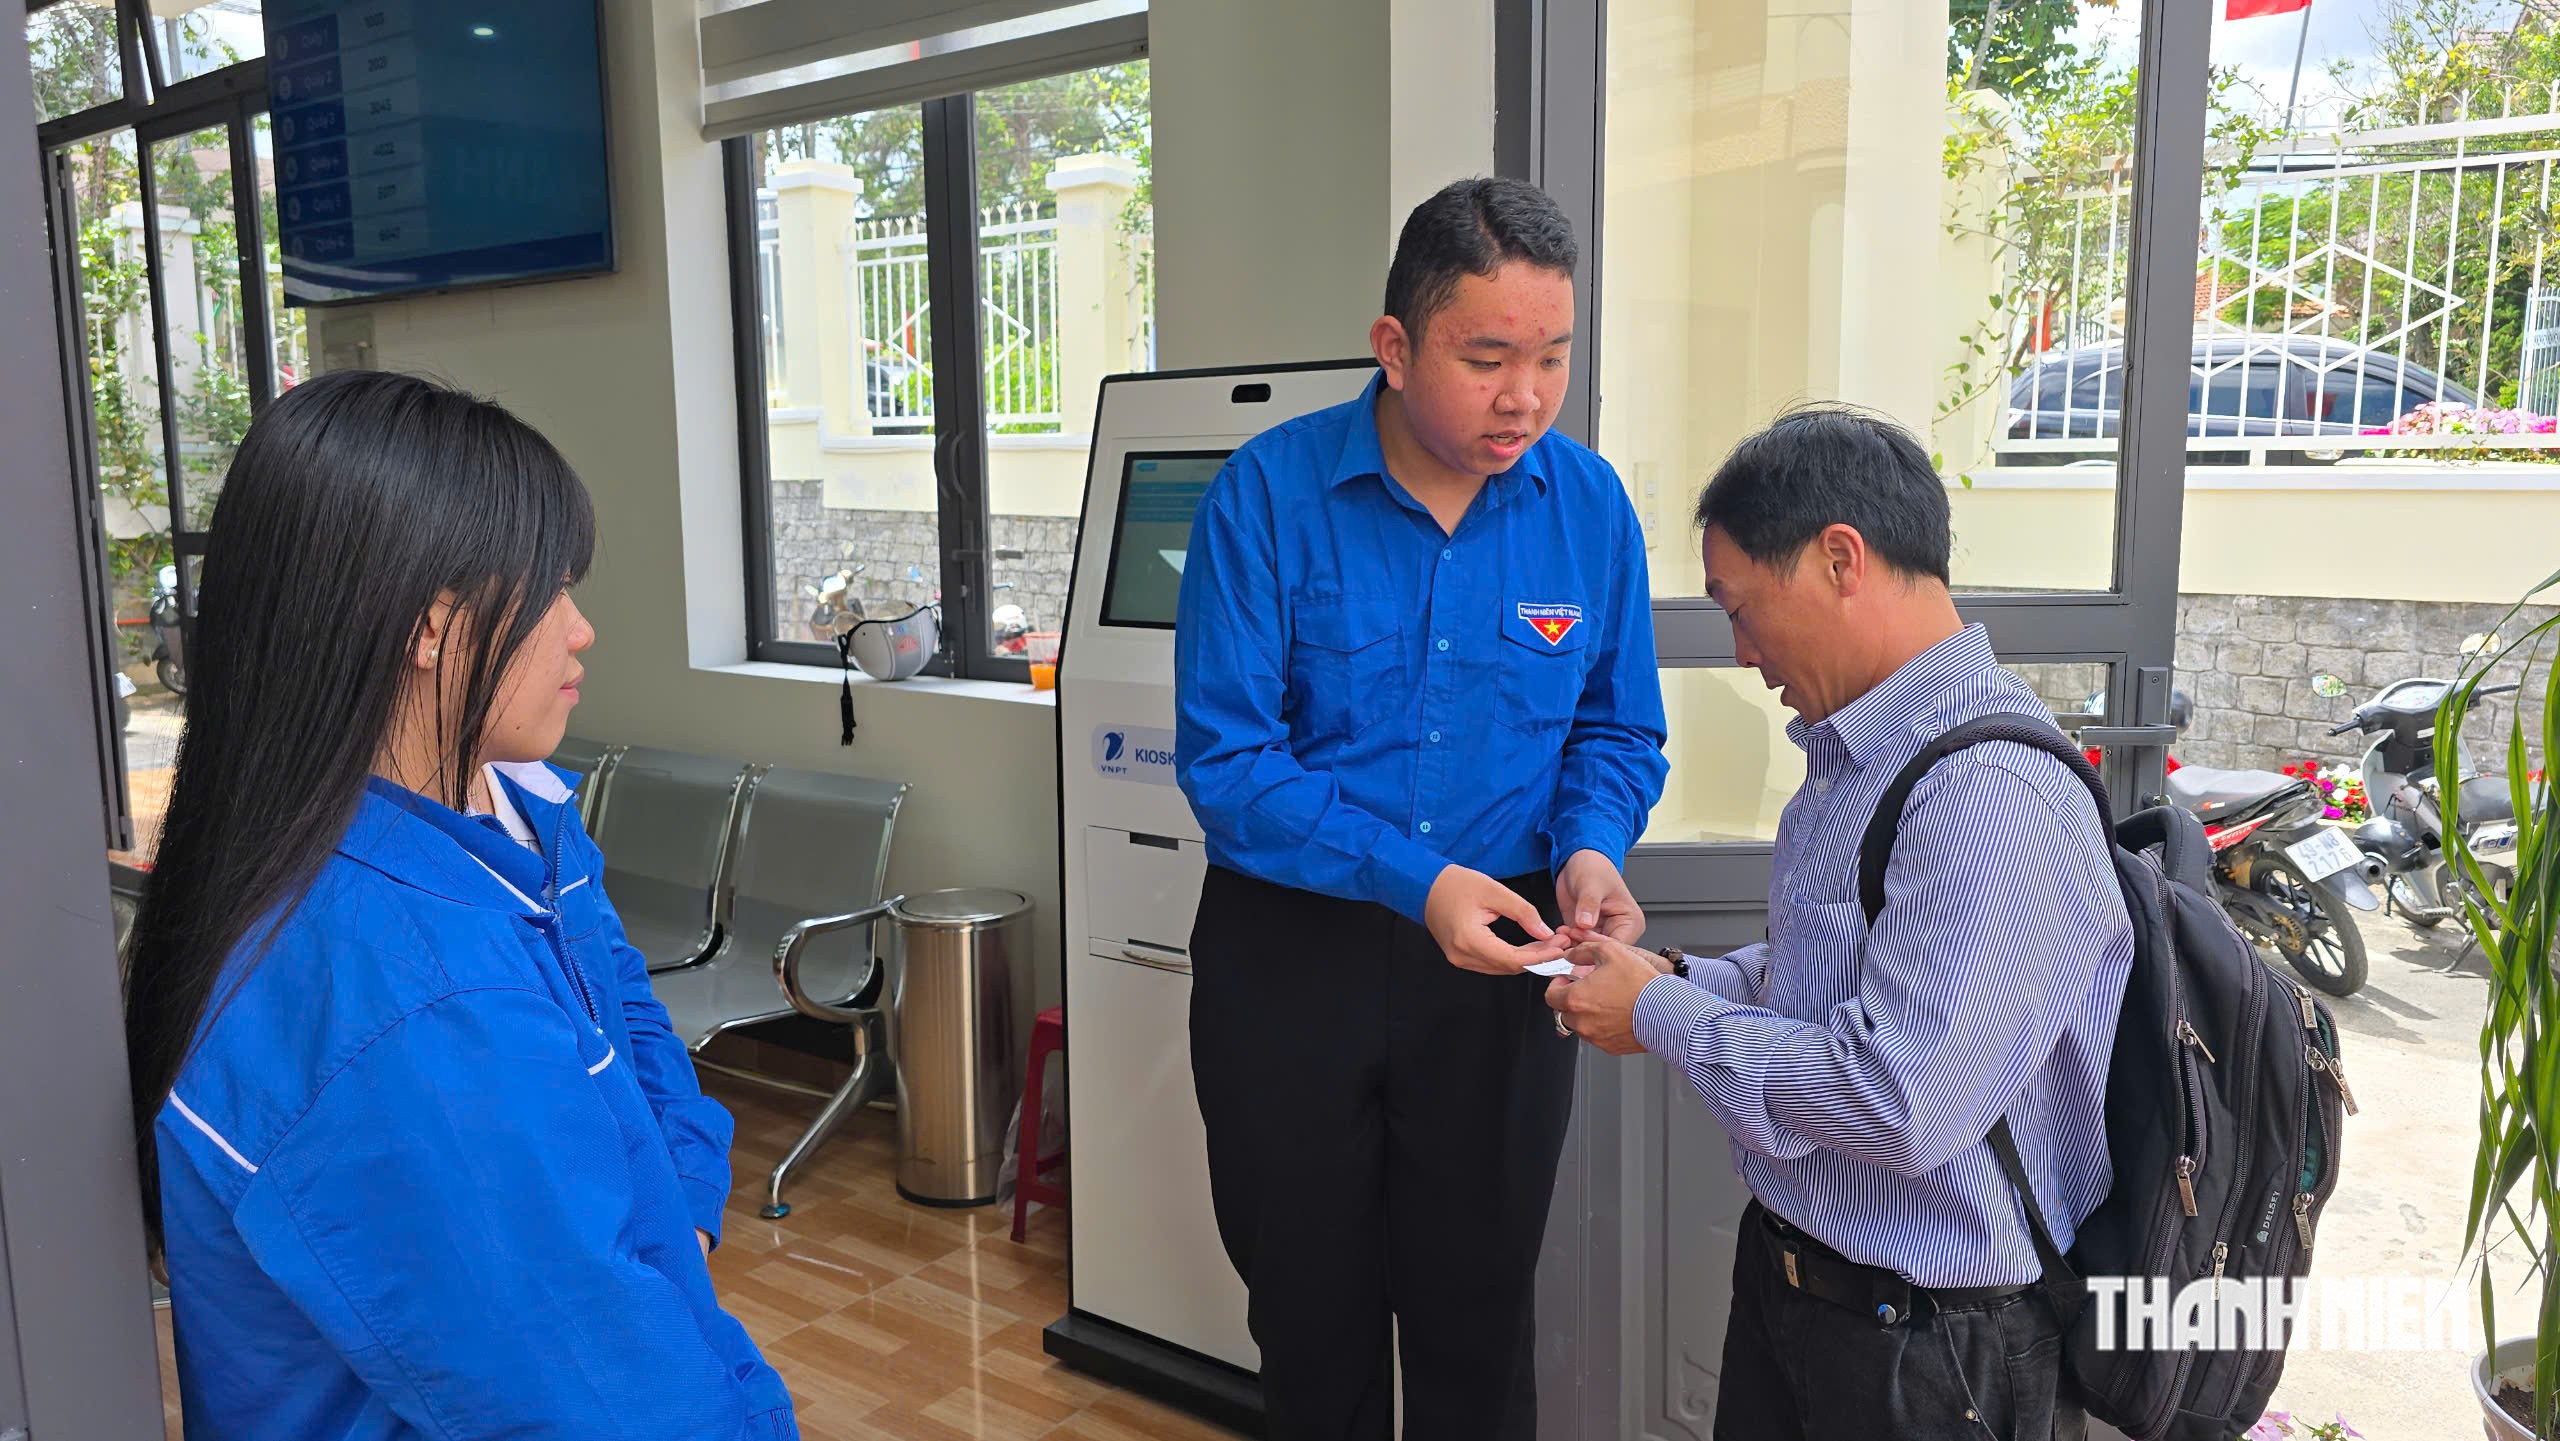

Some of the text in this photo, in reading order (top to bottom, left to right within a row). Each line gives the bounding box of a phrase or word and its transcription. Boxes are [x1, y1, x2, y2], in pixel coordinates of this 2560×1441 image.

[1520, 607, 1539, 616] THANH
[1569, 609, 1580, 617] NAM
[1135, 747, 1176, 767] KIOSK
[1101, 764, 1127, 775] VNPT
[2262, 1190, 2280, 1229] DELSEY
